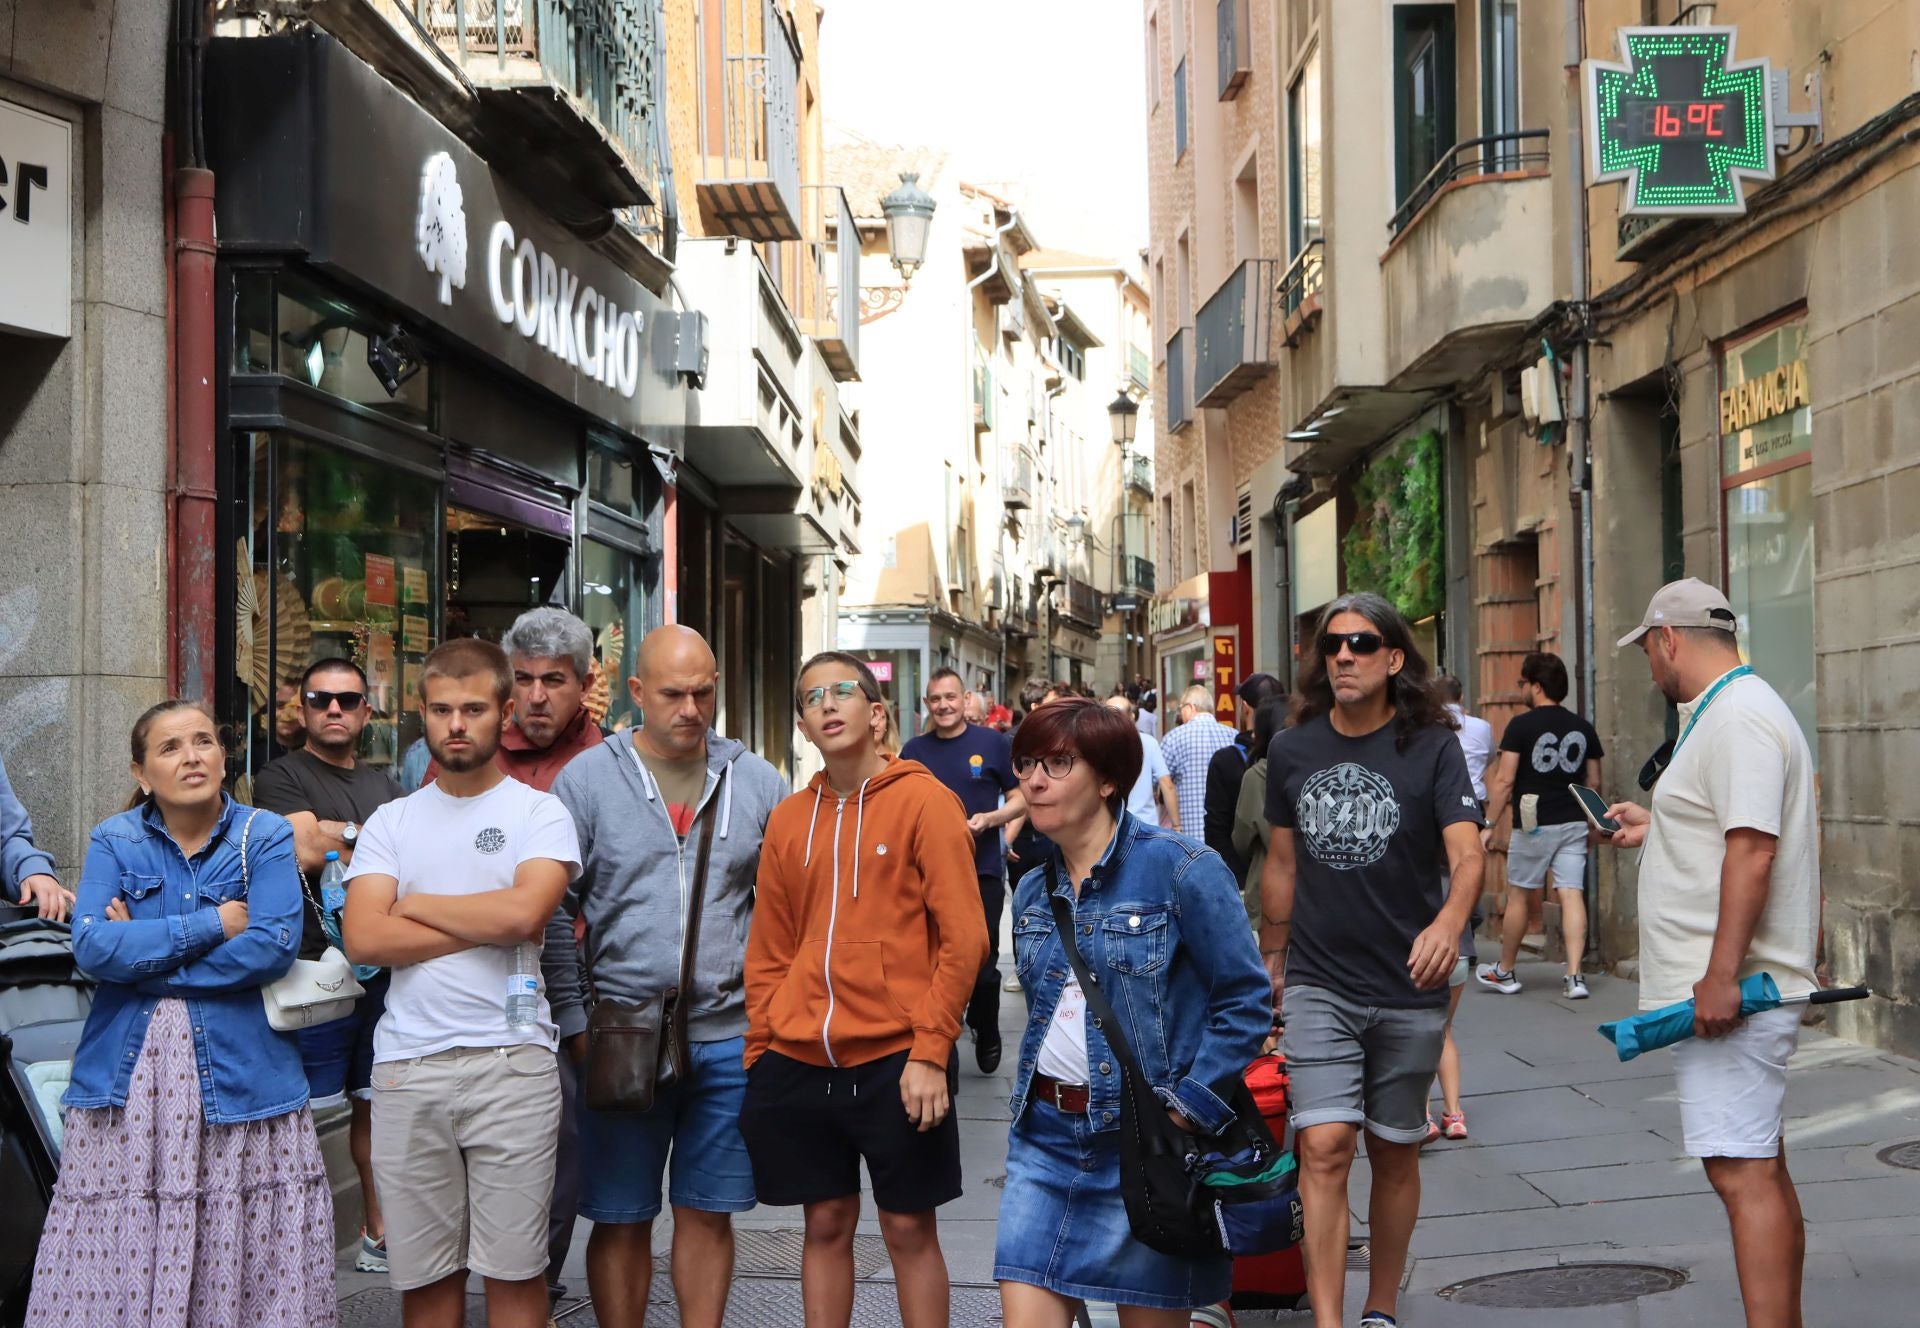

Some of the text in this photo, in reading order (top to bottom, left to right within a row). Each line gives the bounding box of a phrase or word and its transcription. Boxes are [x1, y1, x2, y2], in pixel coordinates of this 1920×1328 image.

[488, 220, 639, 398] CORKCHO
[1720, 361, 1807, 436] FARMACIA
[1532, 730, 1587, 773] 60
[1319, 852, 1366, 862] BLACK ICE
